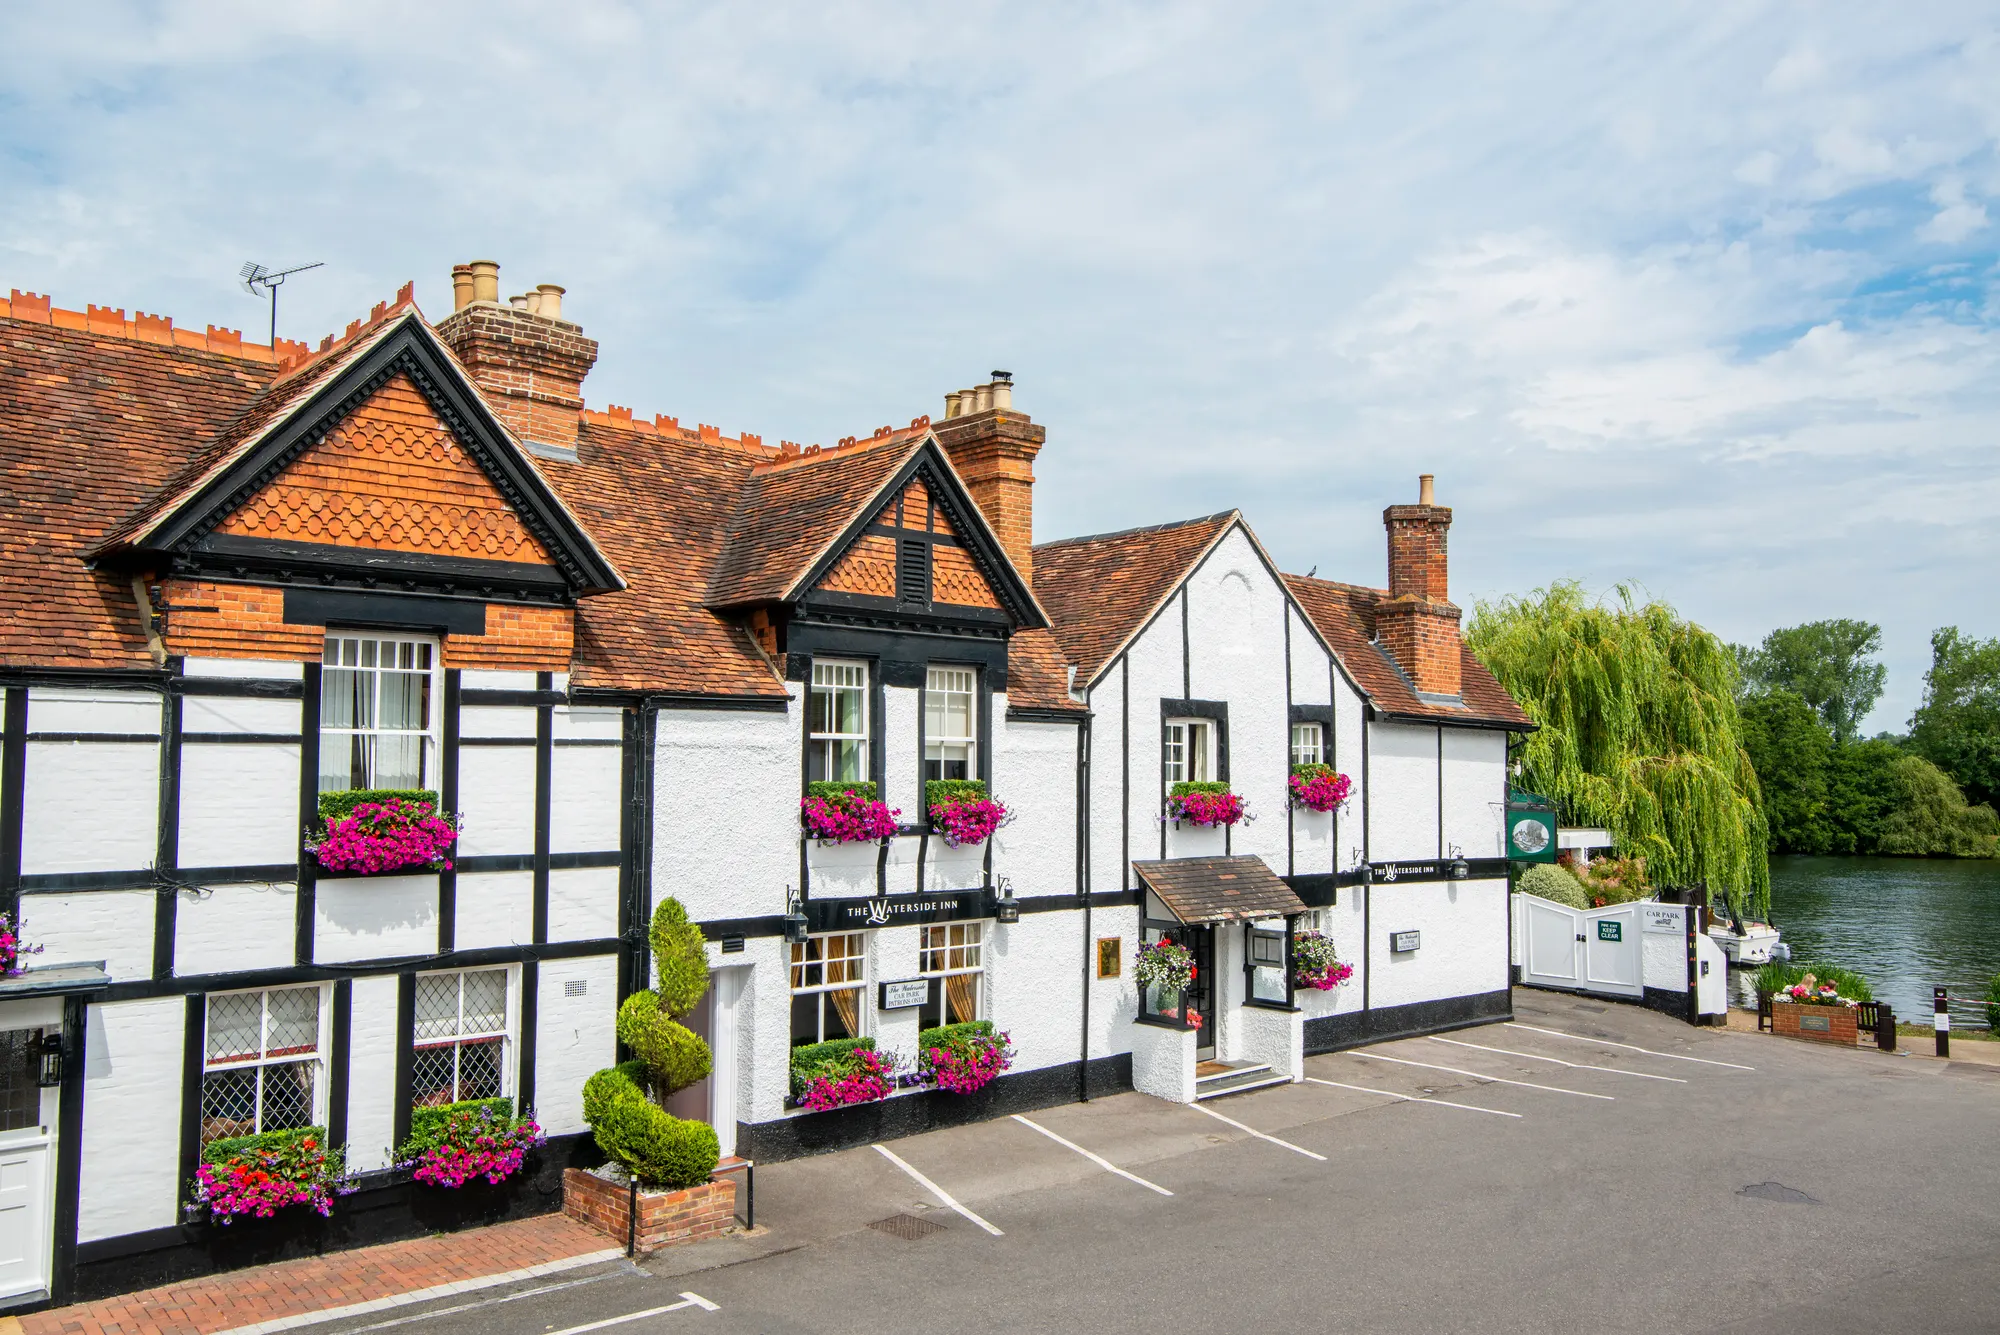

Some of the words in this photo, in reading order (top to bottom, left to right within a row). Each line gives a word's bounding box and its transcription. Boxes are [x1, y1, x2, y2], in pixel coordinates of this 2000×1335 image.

[1384, 864, 1422, 881] WATERSIDE
[847, 907, 868, 917] THE
[866, 900, 937, 924] WATERSIDE
[940, 900, 958, 910] INN
[1646, 910, 1661, 918] CAR
[1661, 912, 1680, 920] PARK
[1600, 932, 1619, 940] CLEAR
